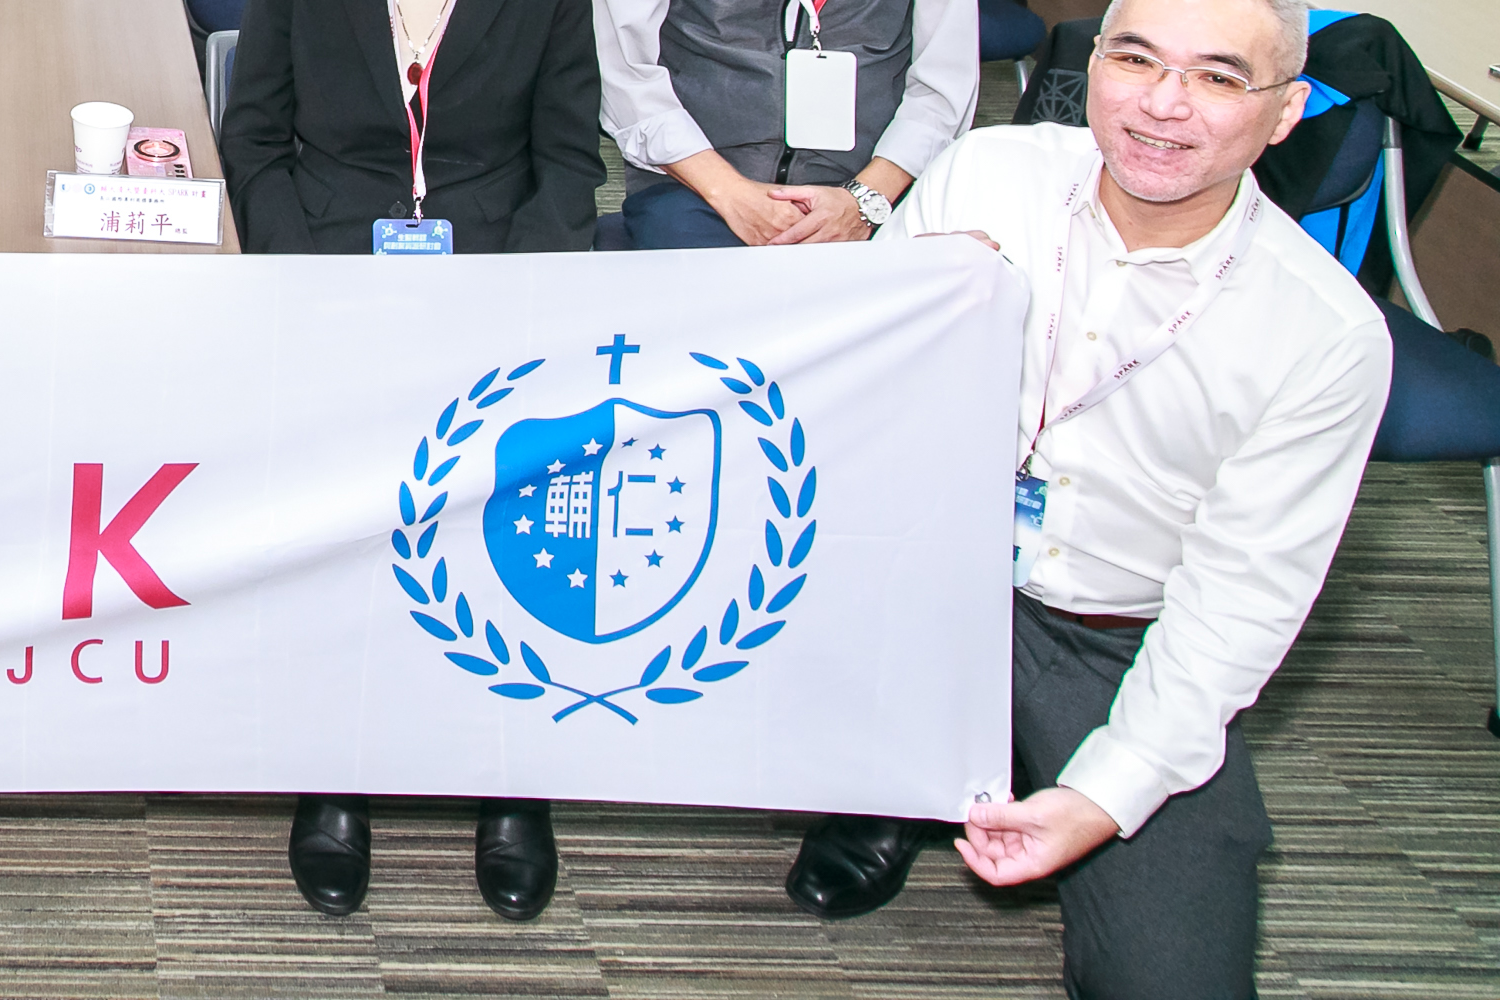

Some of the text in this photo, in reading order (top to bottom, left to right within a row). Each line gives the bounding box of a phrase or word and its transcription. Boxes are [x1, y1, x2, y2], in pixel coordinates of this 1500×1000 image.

[167, 188, 189, 197] SPARK
[1064, 181, 1080, 207] SPARK
[1248, 196, 1261, 222] SPARK
[100, 210, 173, 236] 浦莉平
[1055, 245, 1064, 274] SPARK
[1215, 253, 1237, 280] SPARK
[1046, 312, 1057, 341] SPARK
[1168, 309, 1194, 334] SPARK
[1113, 358, 1141, 381] SPARK
[1059, 401, 1085, 421] SPARK
